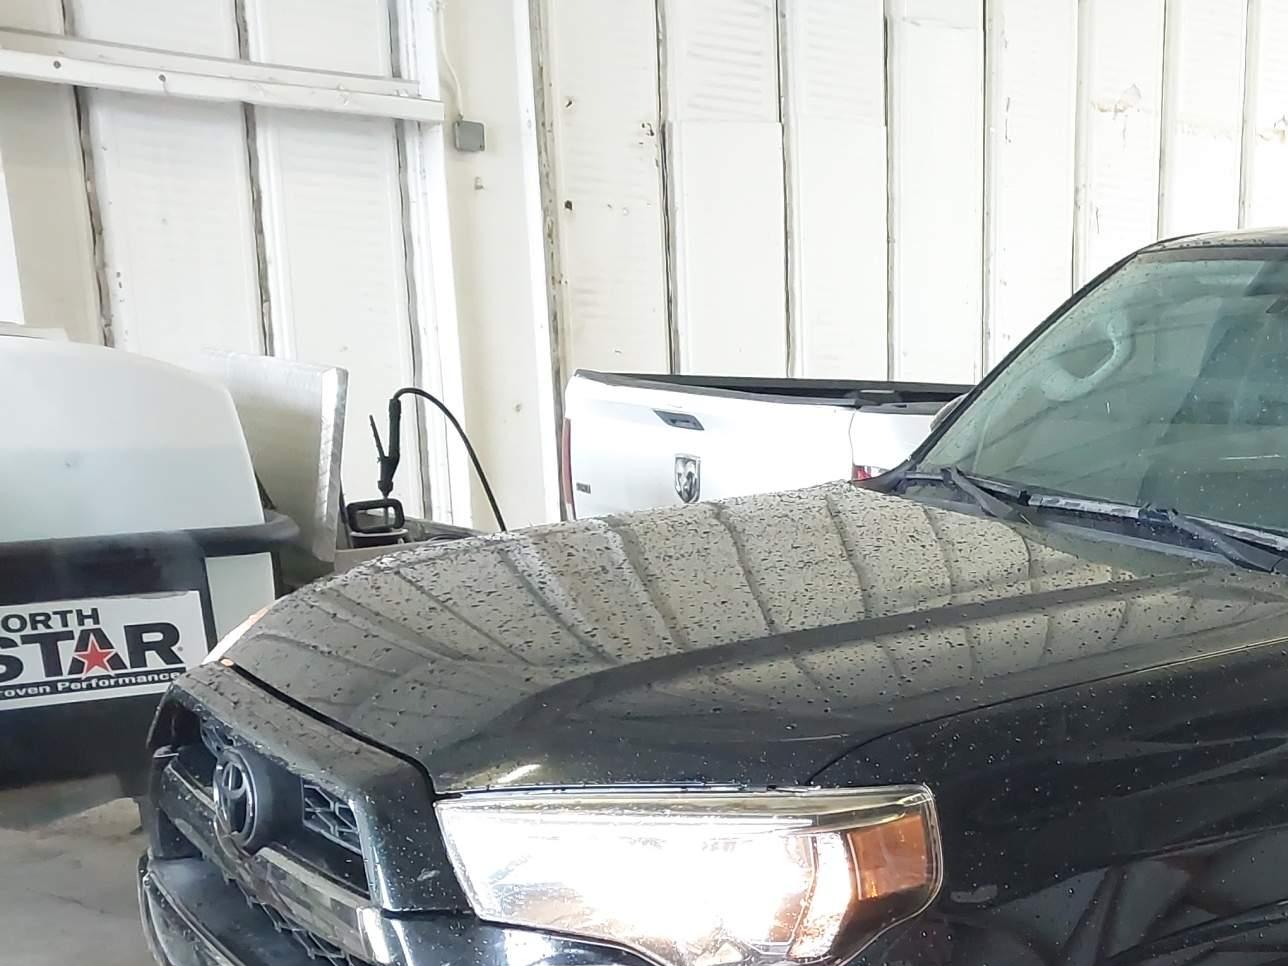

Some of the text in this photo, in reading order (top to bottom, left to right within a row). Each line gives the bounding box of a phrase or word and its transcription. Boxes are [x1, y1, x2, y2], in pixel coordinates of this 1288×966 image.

[0, 607, 100, 633] ORTH
[0, 671, 180, 697] oven Performance
